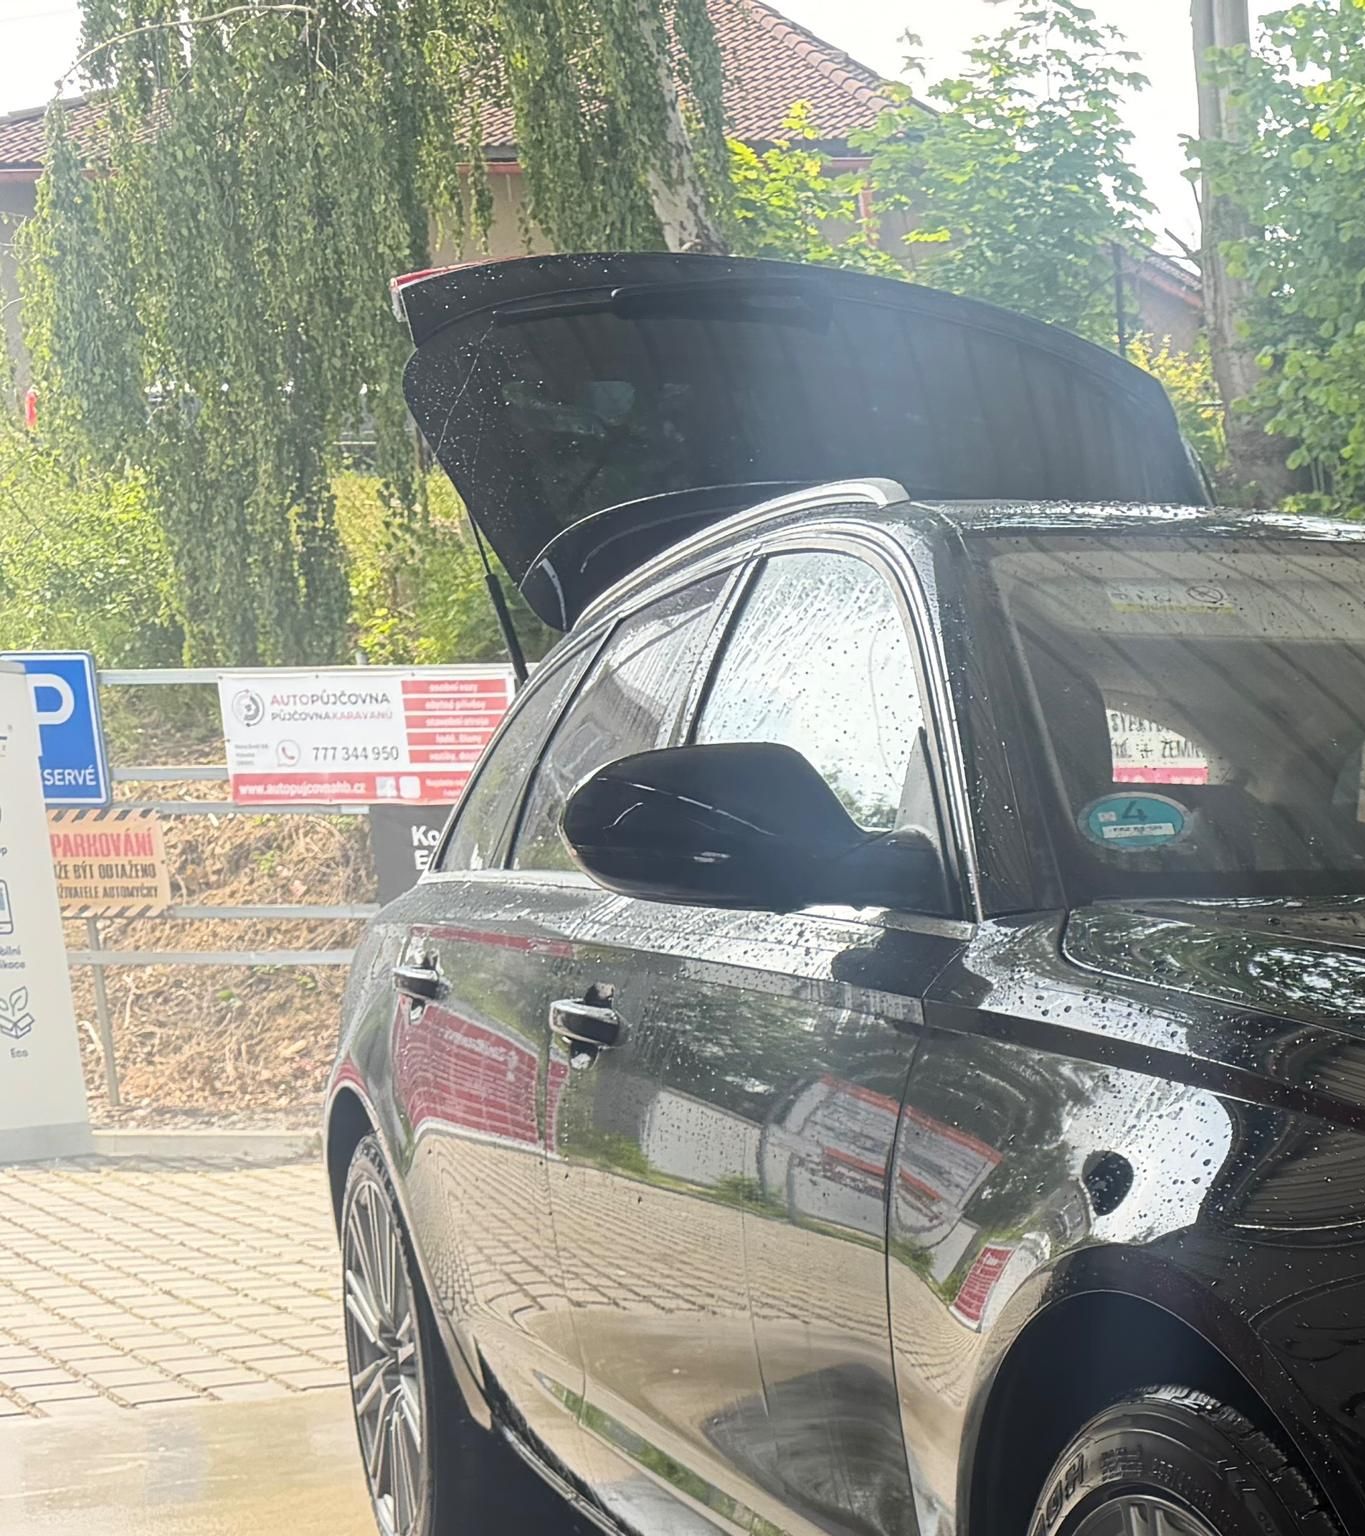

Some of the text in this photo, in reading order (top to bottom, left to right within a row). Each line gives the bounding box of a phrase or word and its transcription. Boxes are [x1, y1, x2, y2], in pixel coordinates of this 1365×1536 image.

[271, 689, 391, 707] AUTOPŮJČOVNA
[26, 673, 75, 756] P
[312, 745, 399, 761] 777 344 950
[40, 765, 96, 786] SERVÉ
[1121, 800, 1148, 821] 4
[51, 827, 154, 858] PARKOVÁNÍ
[54, 860, 157, 879] ŽE BÝT ODTAŽENO
[102, 884, 158, 899] AUTOMYČKY
